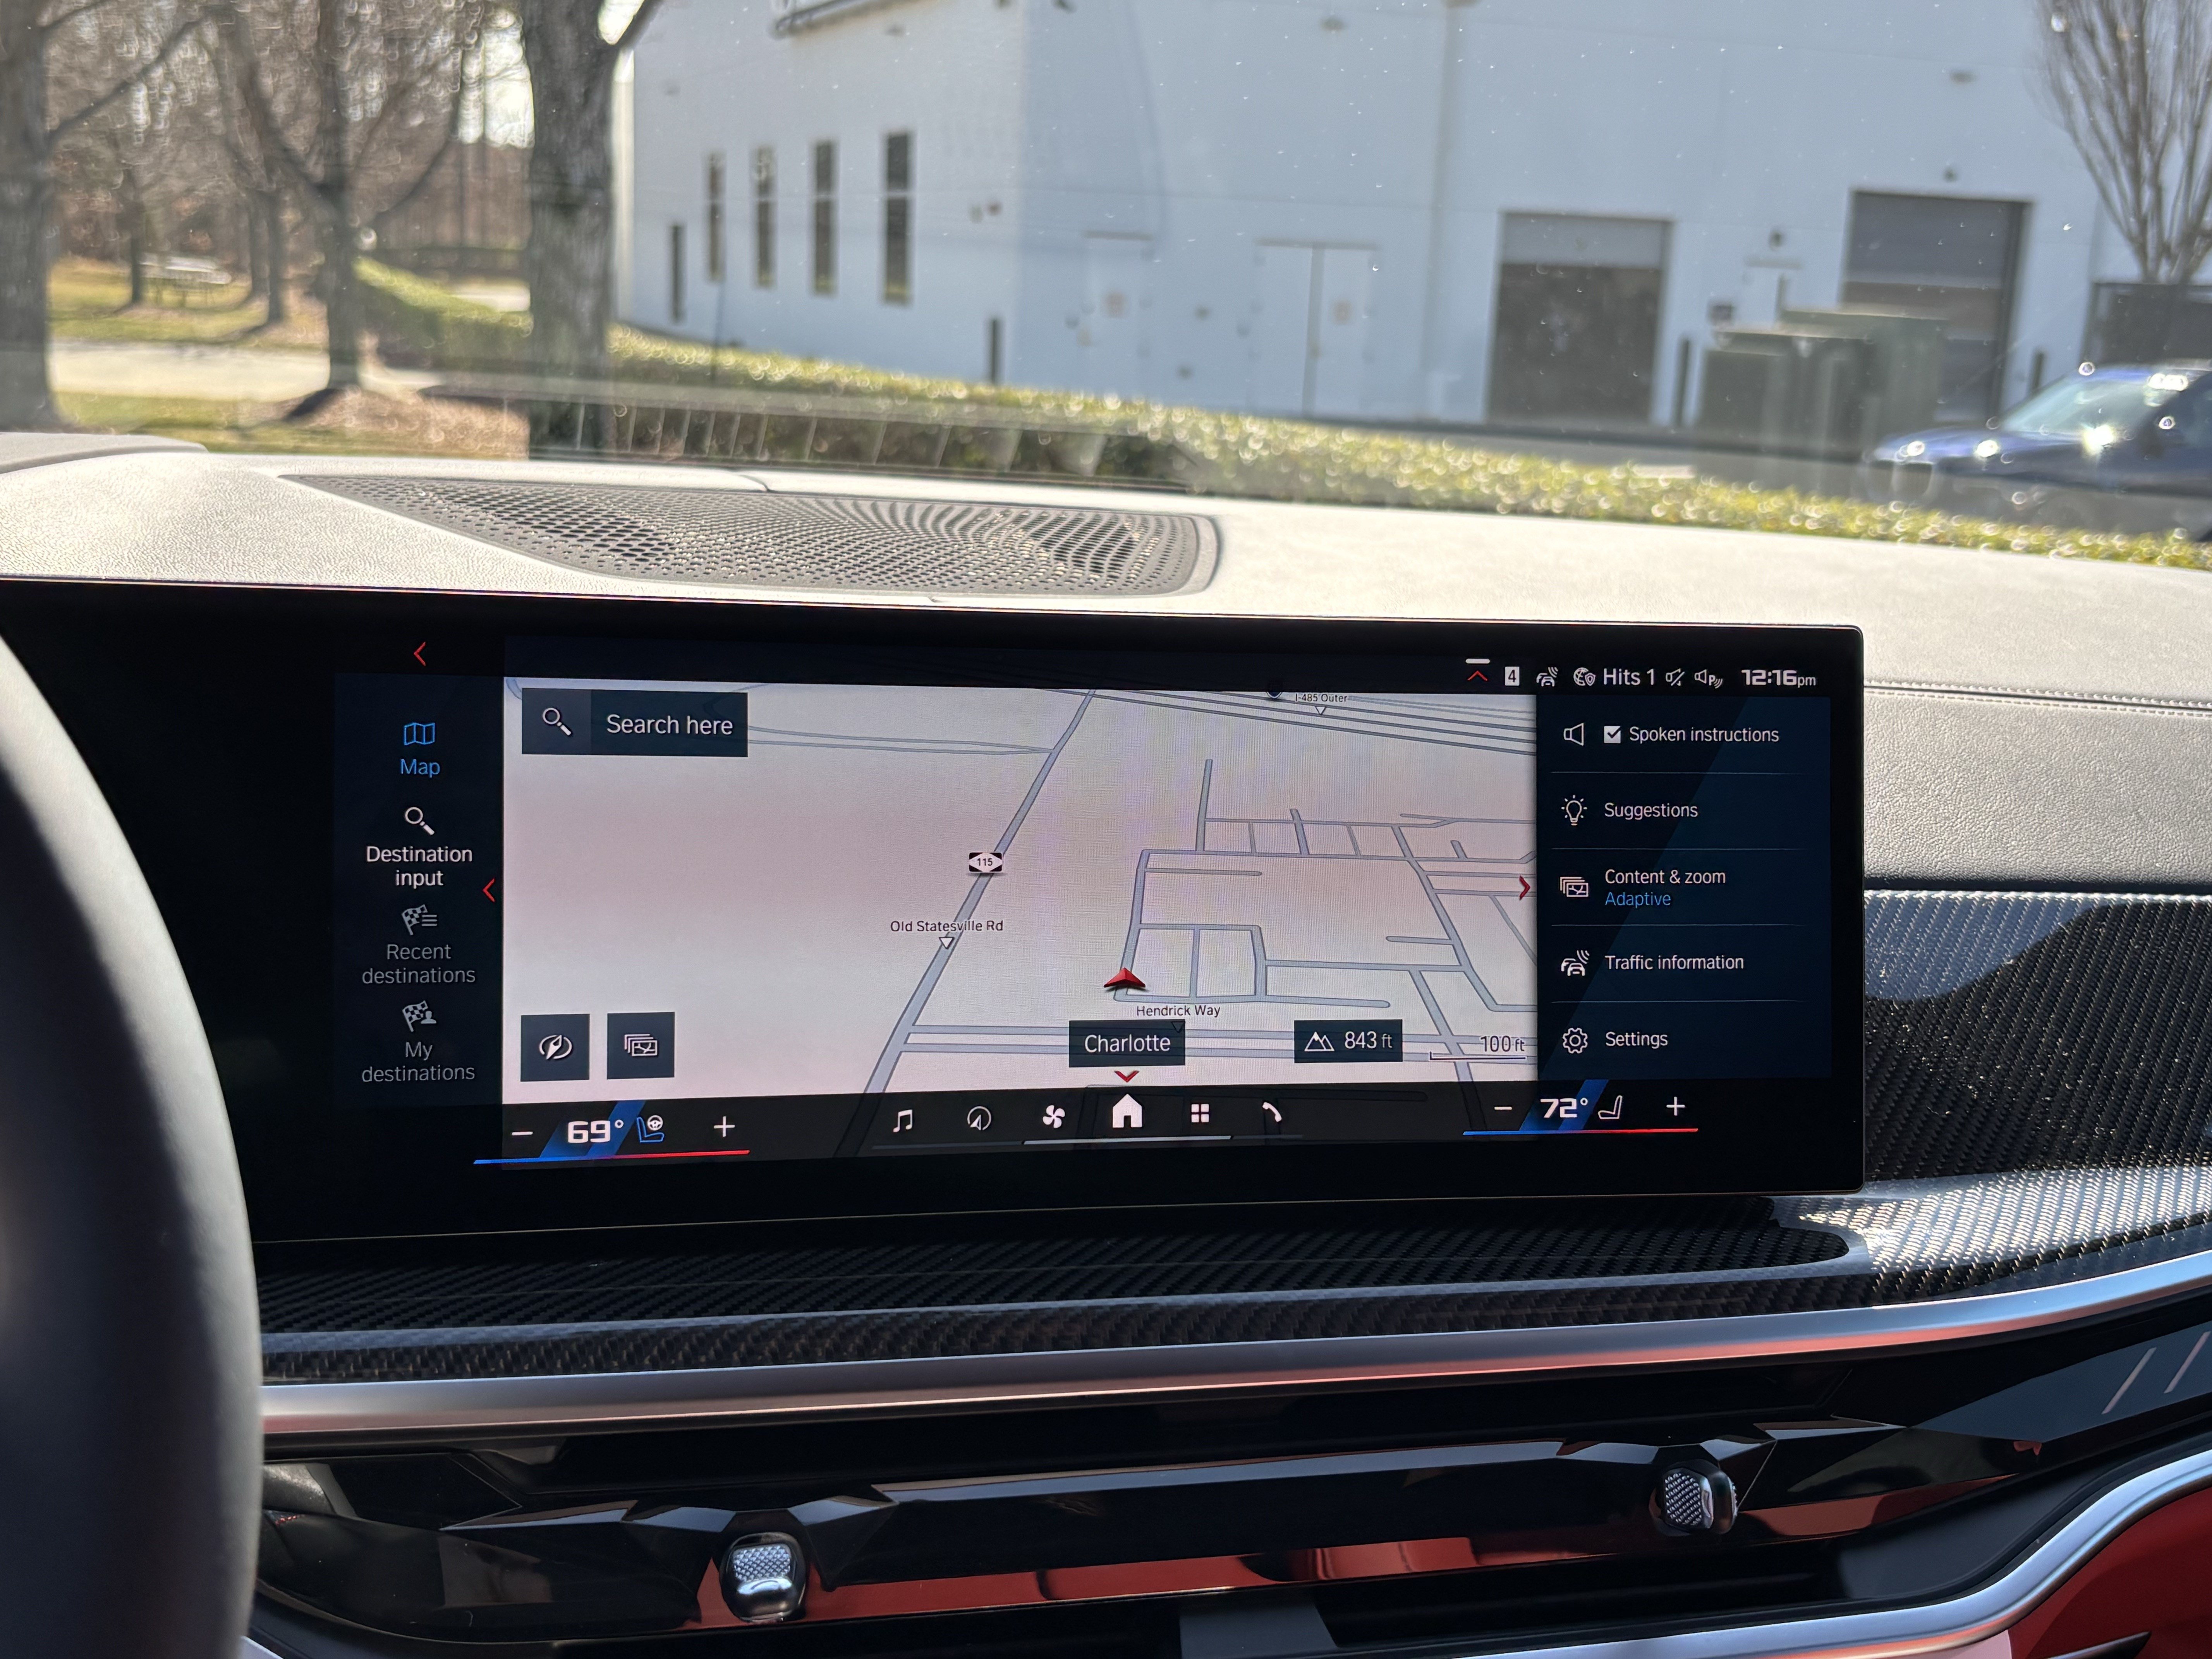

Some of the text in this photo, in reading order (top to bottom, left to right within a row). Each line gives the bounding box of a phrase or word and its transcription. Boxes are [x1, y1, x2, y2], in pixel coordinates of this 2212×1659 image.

[1604, 668, 1654, 685] Hits 1
[1295, 693, 1347, 702] I-485 Outer
[607, 714, 733, 735] Search here
[1630, 726, 1779, 744] Spoken instructions
[400, 759, 440, 778] Map
[1604, 802, 1698, 820] Suggestions
[367, 846, 472, 862] Destination
[977, 857, 993, 866] 115
[396, 869, 444, 889] input
[1605, 869, 1726, 884] Content & zoom
[1605, 891, 1671, 908] Adaptive
[890, 920, 1003, 932] Old Statesville Rd
[387, 944, 451, 960] Recent
[1604, 955, 1744, 970] Traffic information
[362, 967, 476, 984] destinations
[1137, 1004, 1221, 1018] Hendrick Way
[1085, 1034, 1171, 1053] Charlotte
[1345, 1031, 1392, 1049] 843 ft
[1480, 1036, 1525, 1052] 100 ft
[1606, 1031, 1668, 1049] Settings
[405, 1041, 433, 1061] My
[362, 1065, 475, 1082] destinations
